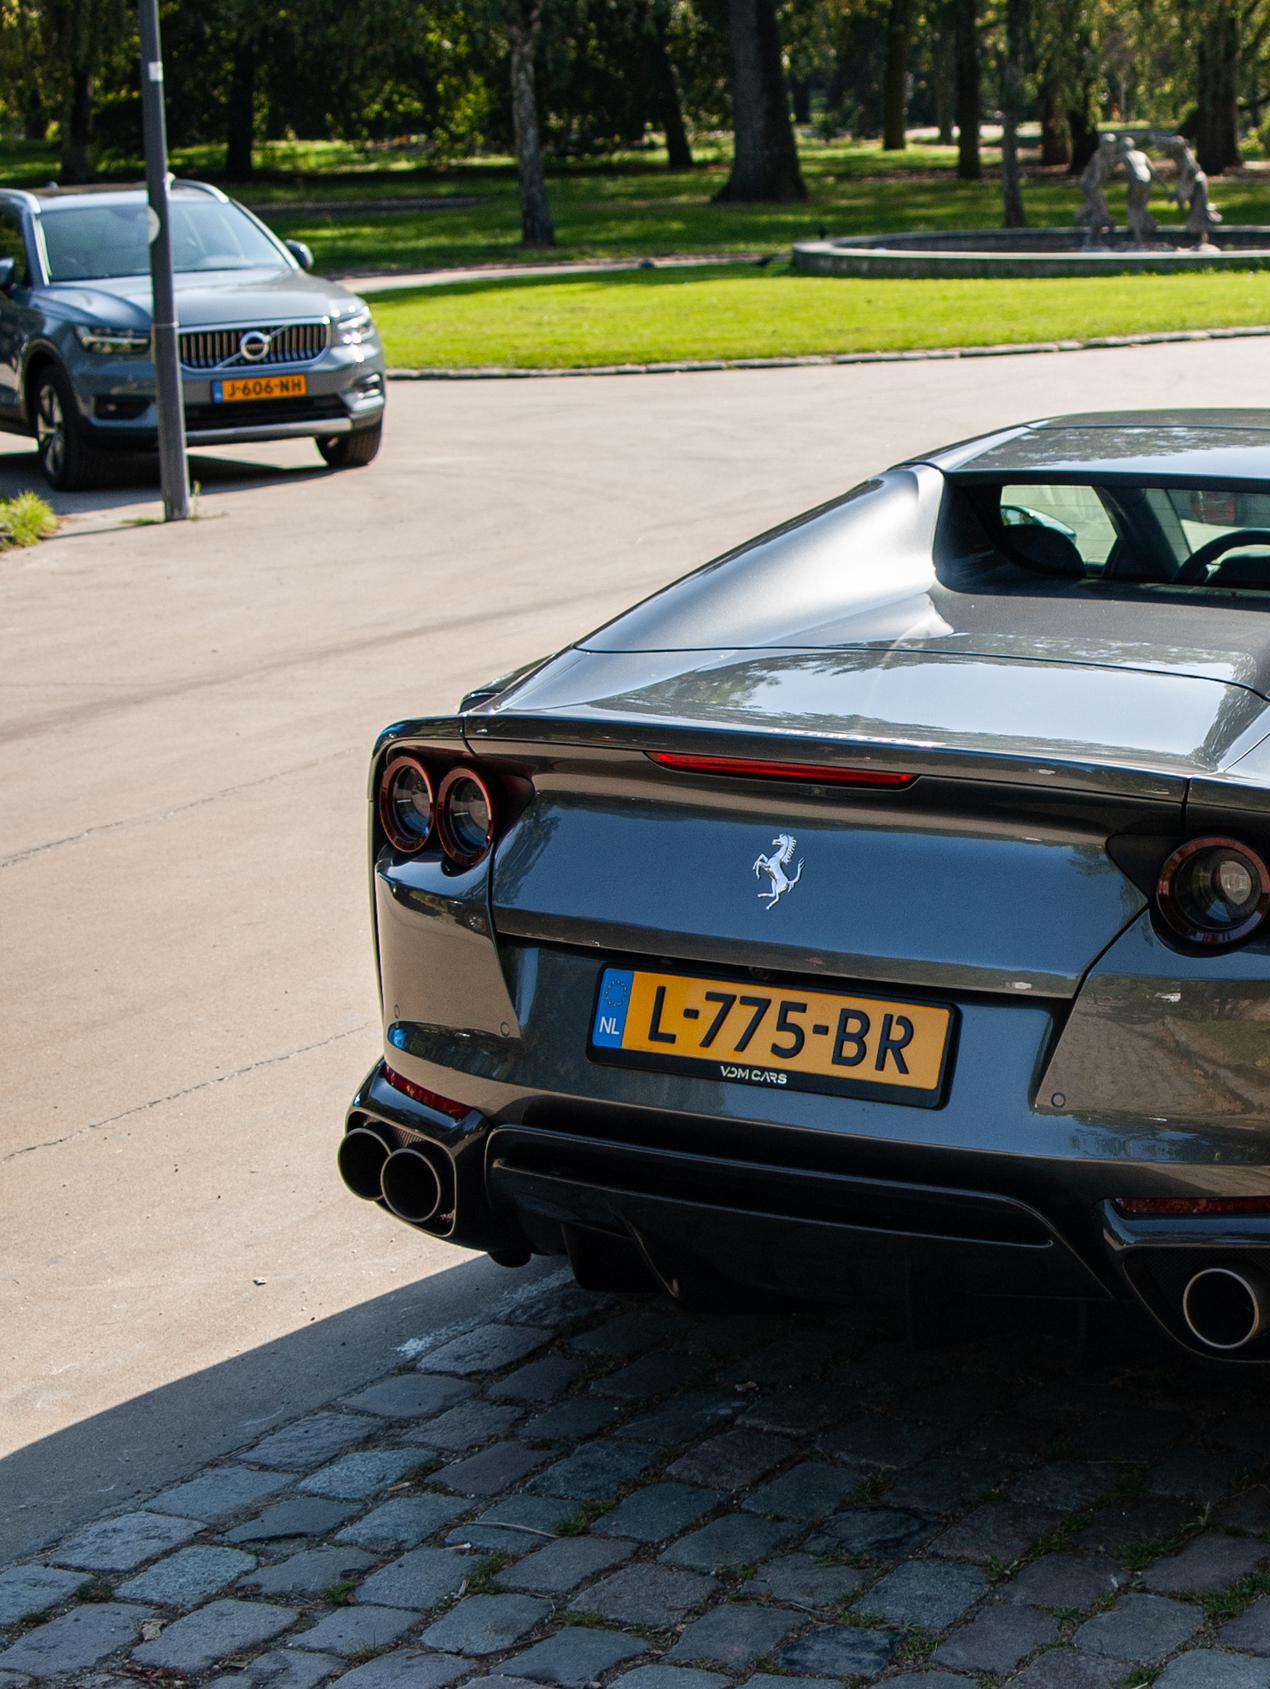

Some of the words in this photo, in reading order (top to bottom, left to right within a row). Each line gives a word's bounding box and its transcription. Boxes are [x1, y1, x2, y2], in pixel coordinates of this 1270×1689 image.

[228, 378, 302, 397] J-606-NH
[599, 1015, 621, 1036] NL
[647, 985, 916, 1075] L-775-BR
[720, 1065, 751, 1081] VDM
[751, 1069, 788, 1086] CARS
